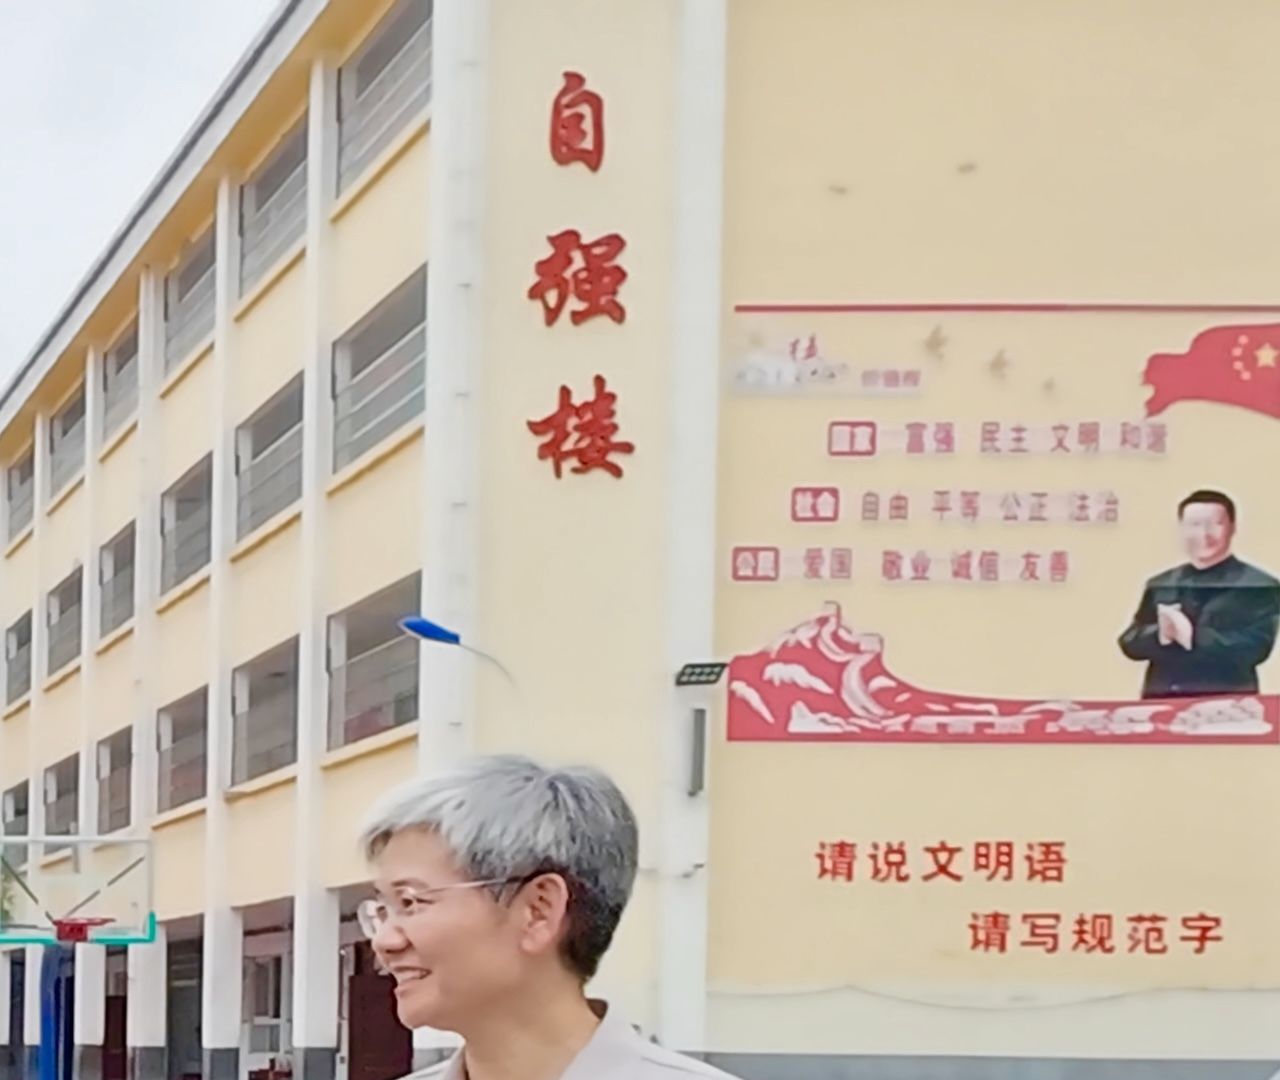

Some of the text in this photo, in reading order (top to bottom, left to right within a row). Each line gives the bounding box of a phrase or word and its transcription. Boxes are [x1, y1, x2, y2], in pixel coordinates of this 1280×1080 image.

[527, 71, 635, 479] 自强楼
[981, 422, 1028, 452] 民主
[1050, 422, 1100, 452] 文明
[862, 490, 909, 520] 自由
[932, 491, 981, 522] 平等
[1000, 493, 1048, 521] 公正
[803, 548, 852, 579] 爱国
[815, 841, 1067, 883] 请说文明语
[967, 911, 1224, 955] 请写规范字
